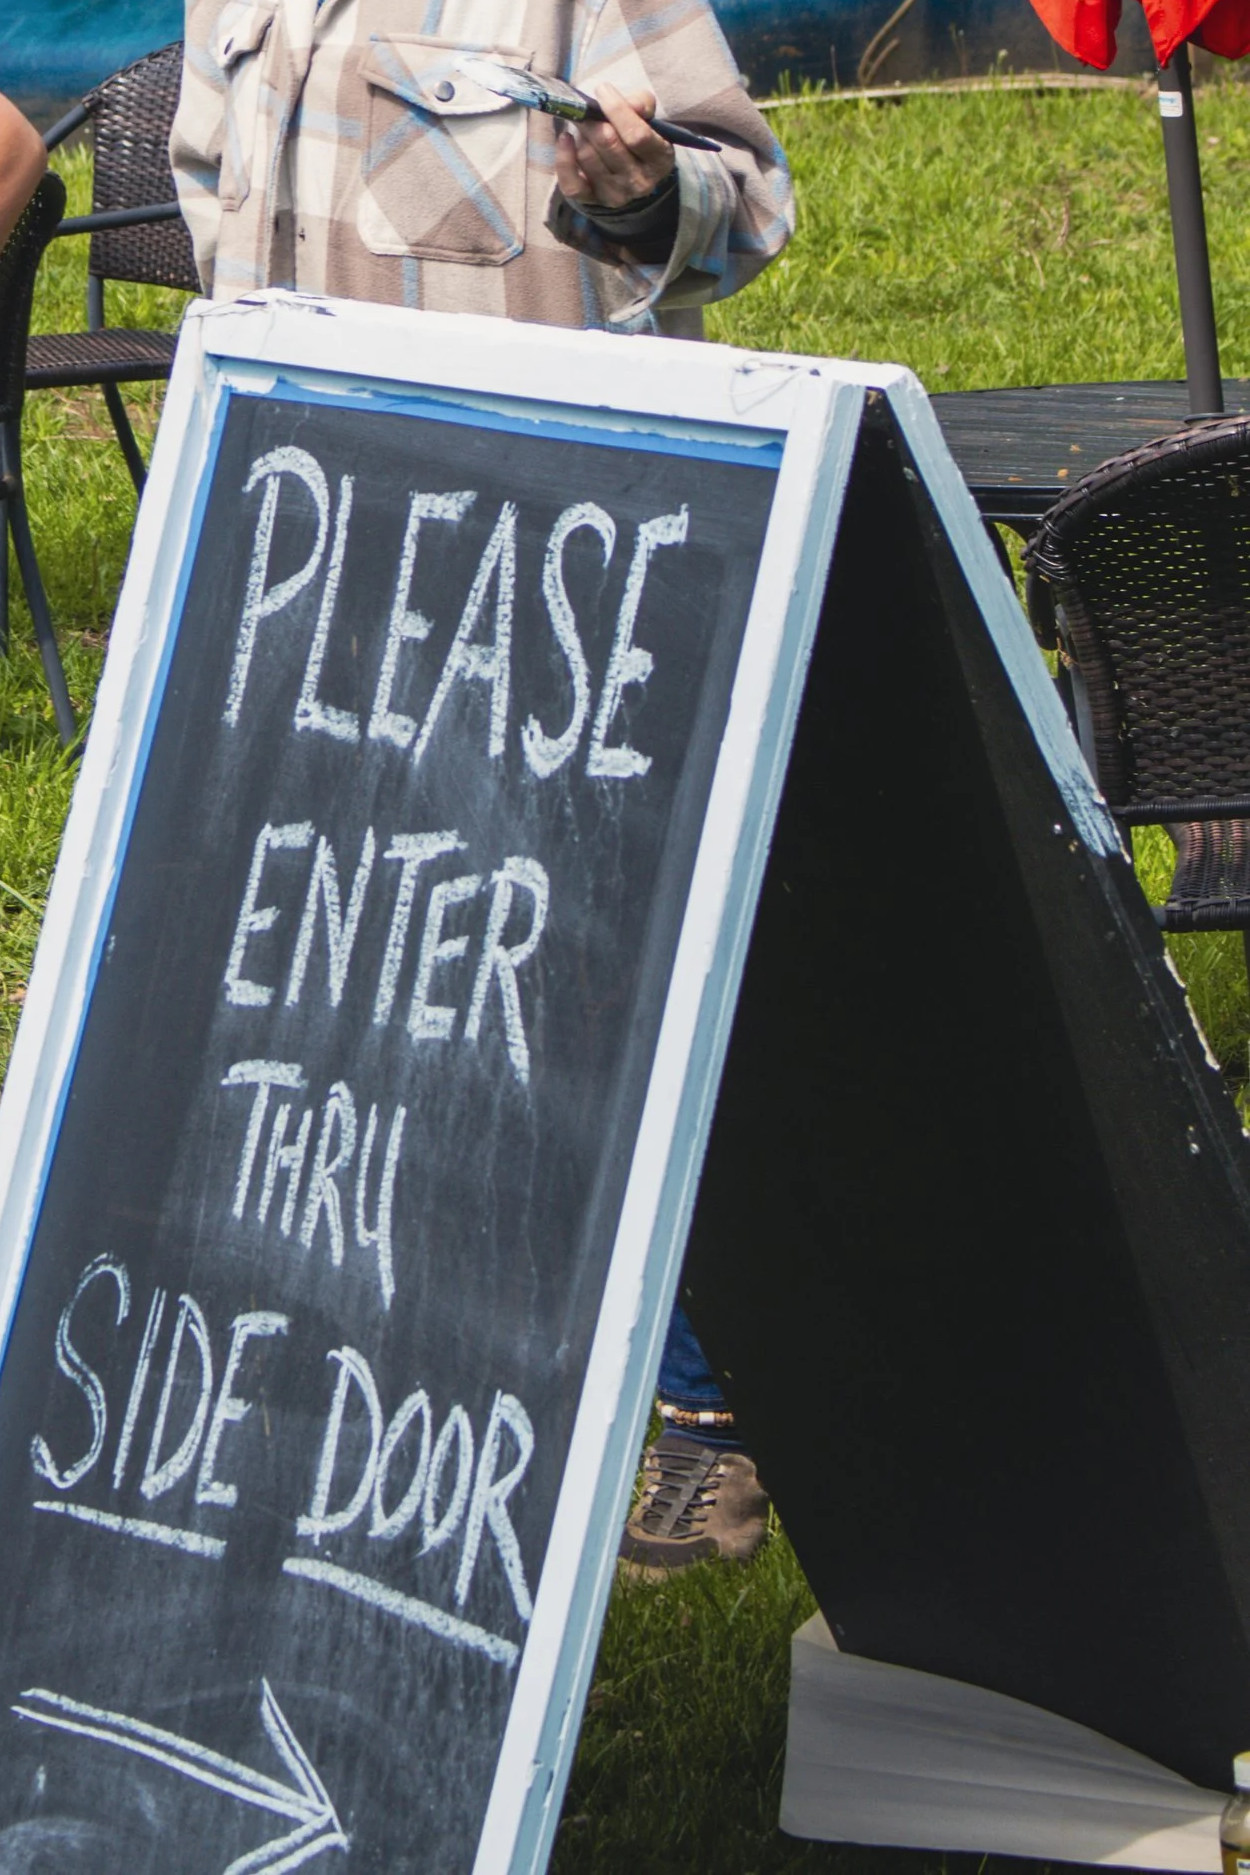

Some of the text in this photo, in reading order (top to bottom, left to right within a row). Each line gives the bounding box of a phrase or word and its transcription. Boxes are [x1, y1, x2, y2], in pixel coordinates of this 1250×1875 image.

[221, 445, 688, 779] PLEASE
[224, 820, 548, 1085] ENTER
[220, 1059, 407, 1311] THRU
[30, 1252, 534, 1621] SIDE DOOR
